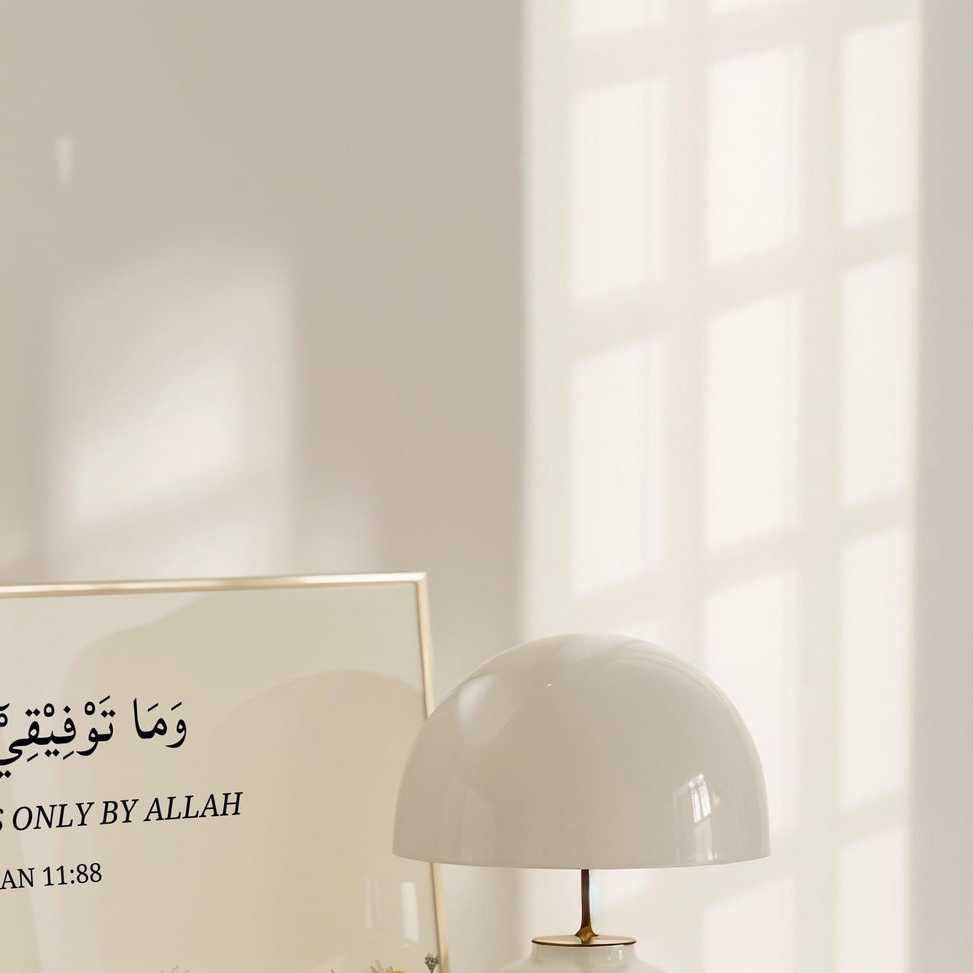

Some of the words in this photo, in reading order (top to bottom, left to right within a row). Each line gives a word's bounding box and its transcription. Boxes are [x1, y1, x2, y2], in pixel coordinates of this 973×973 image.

[12, 801, 95, 832] ONLY
[99, 798, 140, 826] BY
[142, 791, 244, 823] ALLAH
[42, 862, 103, 887] 11:88
